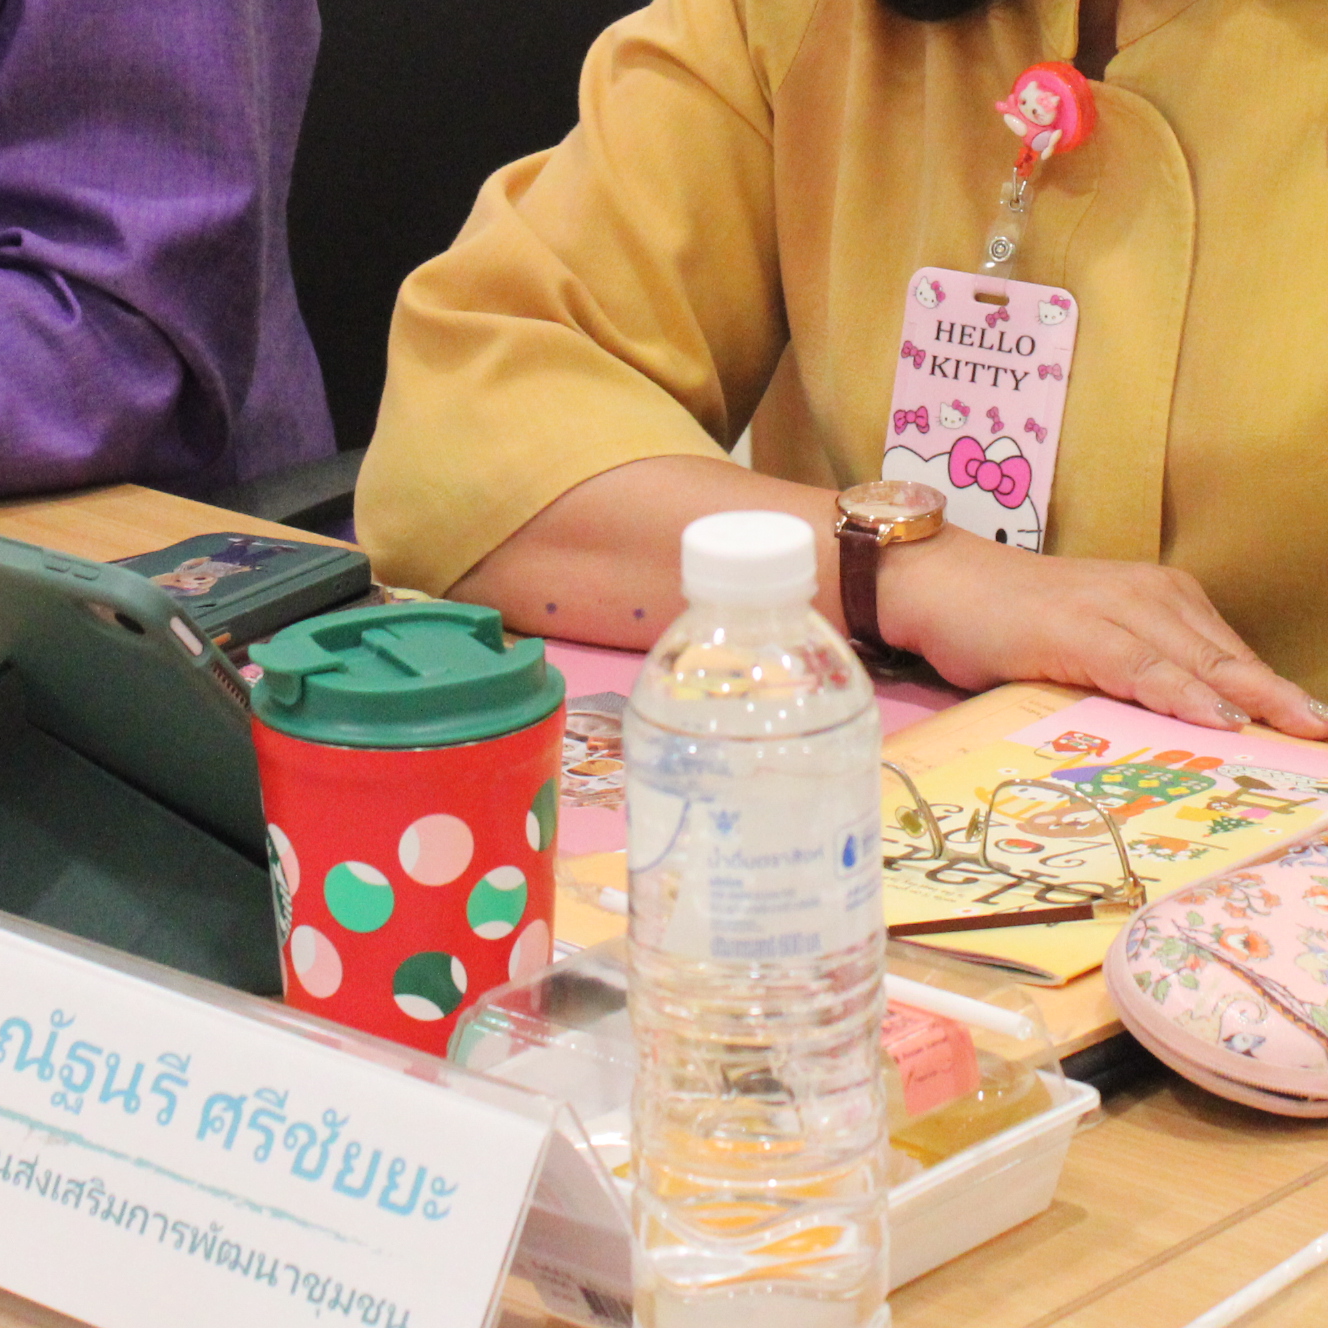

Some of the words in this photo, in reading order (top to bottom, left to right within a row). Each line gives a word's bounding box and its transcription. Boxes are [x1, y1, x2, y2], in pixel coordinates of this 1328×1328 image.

[934, 320, 1036, 357] HELLO
[928, 354, 1031, 392] KITTY
[196, 1086, 459, 1221] ศรีชัยยะ
